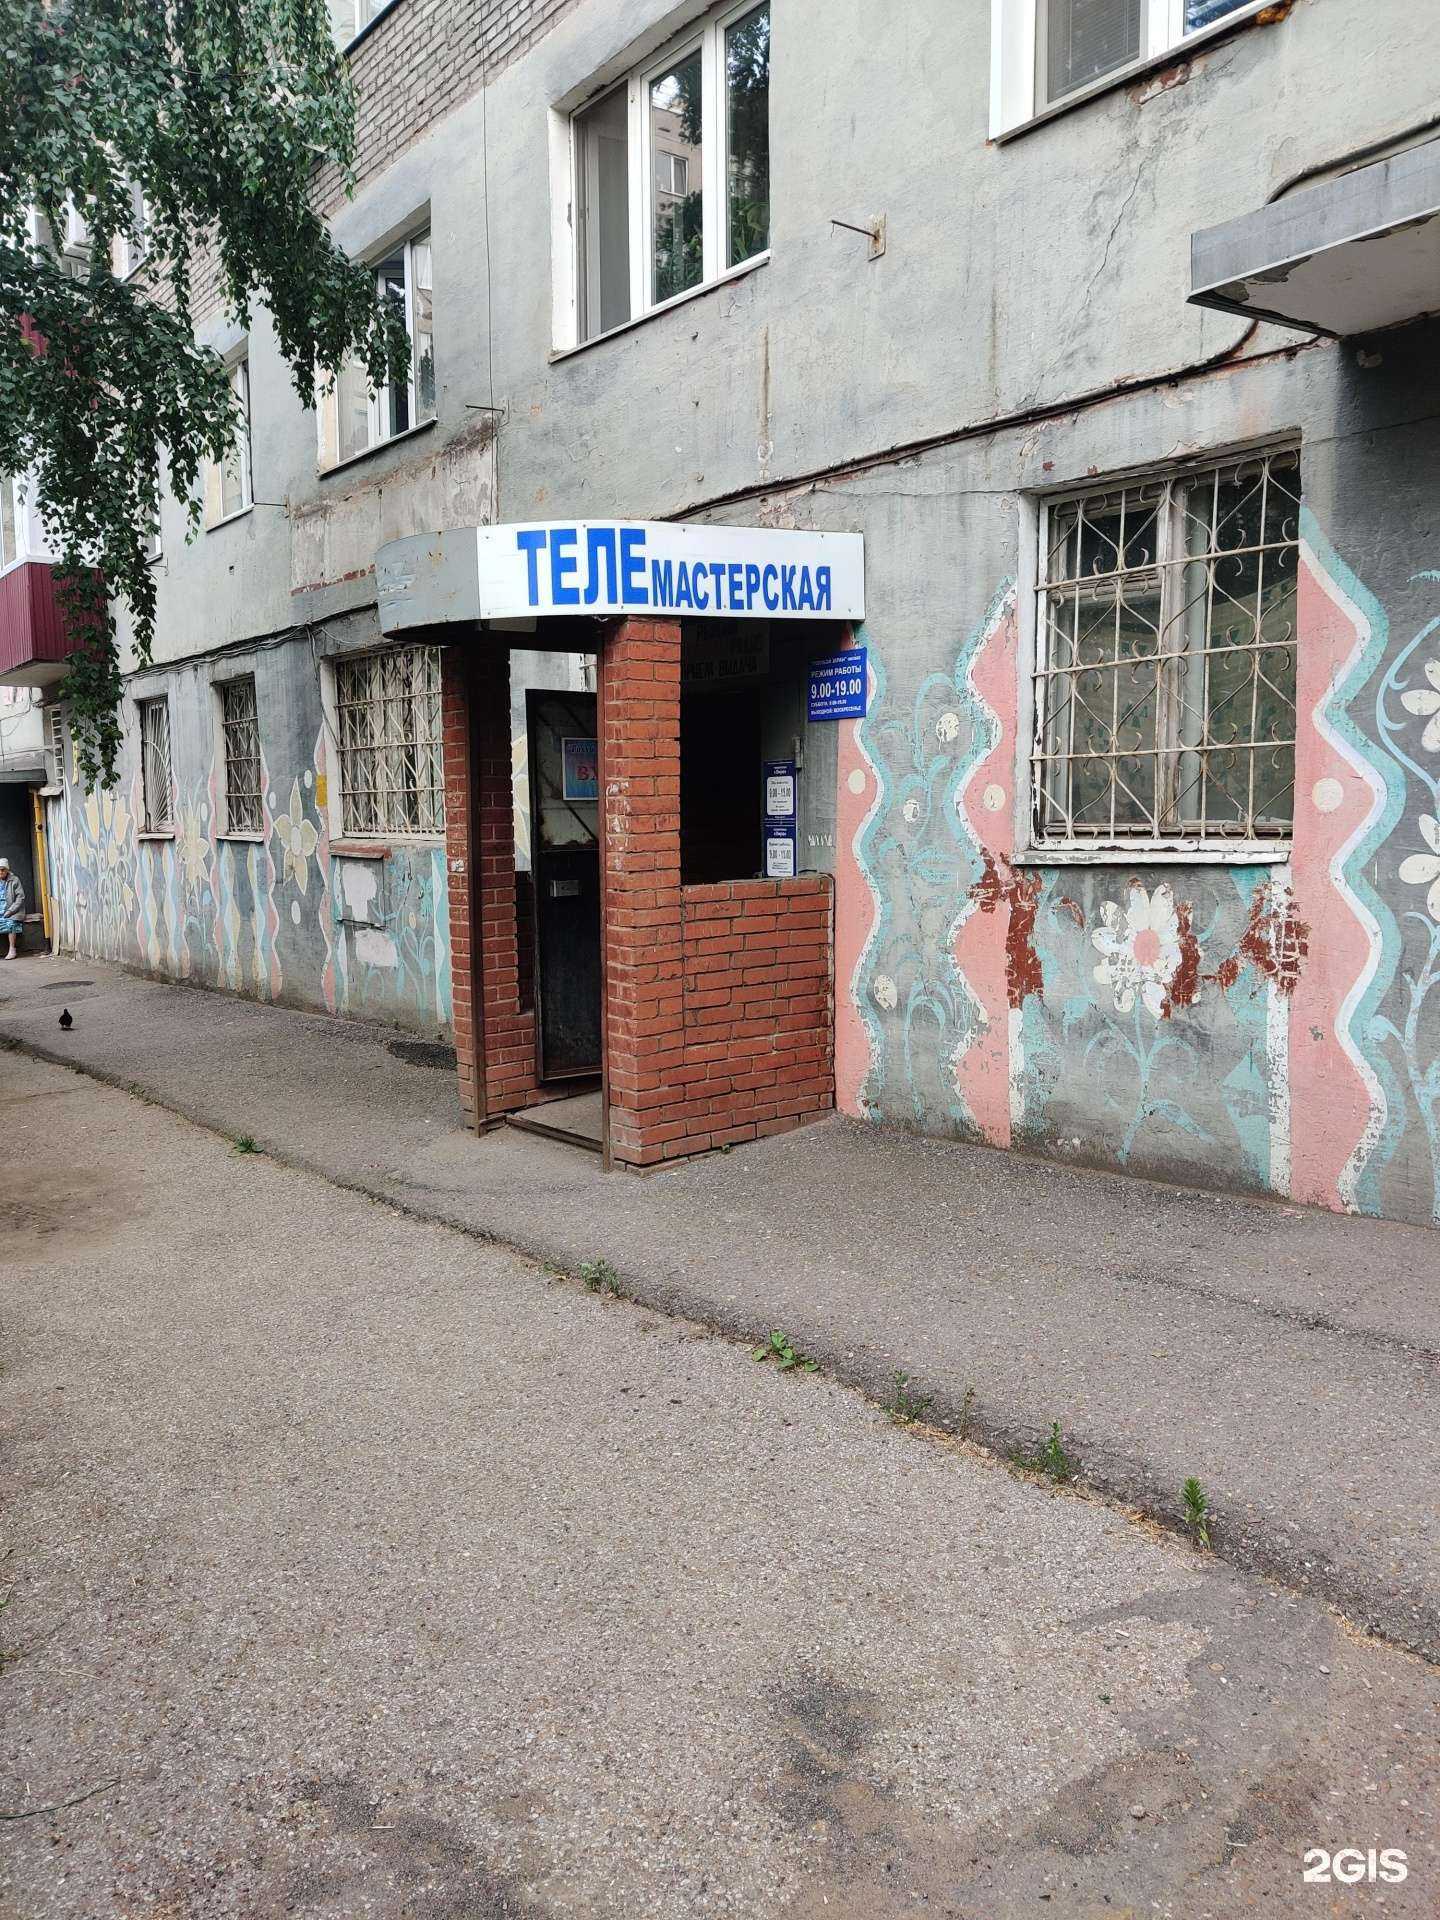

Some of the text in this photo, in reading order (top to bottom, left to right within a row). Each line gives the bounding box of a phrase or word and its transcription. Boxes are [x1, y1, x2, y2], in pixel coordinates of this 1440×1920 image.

[516, 528, 831, 611] ТЕЛЕМАСТЕРСКАЯ
[834, 665, 862, 676] РАБОТЫ
[811, 678, 861, 699] 9.00-19.00
